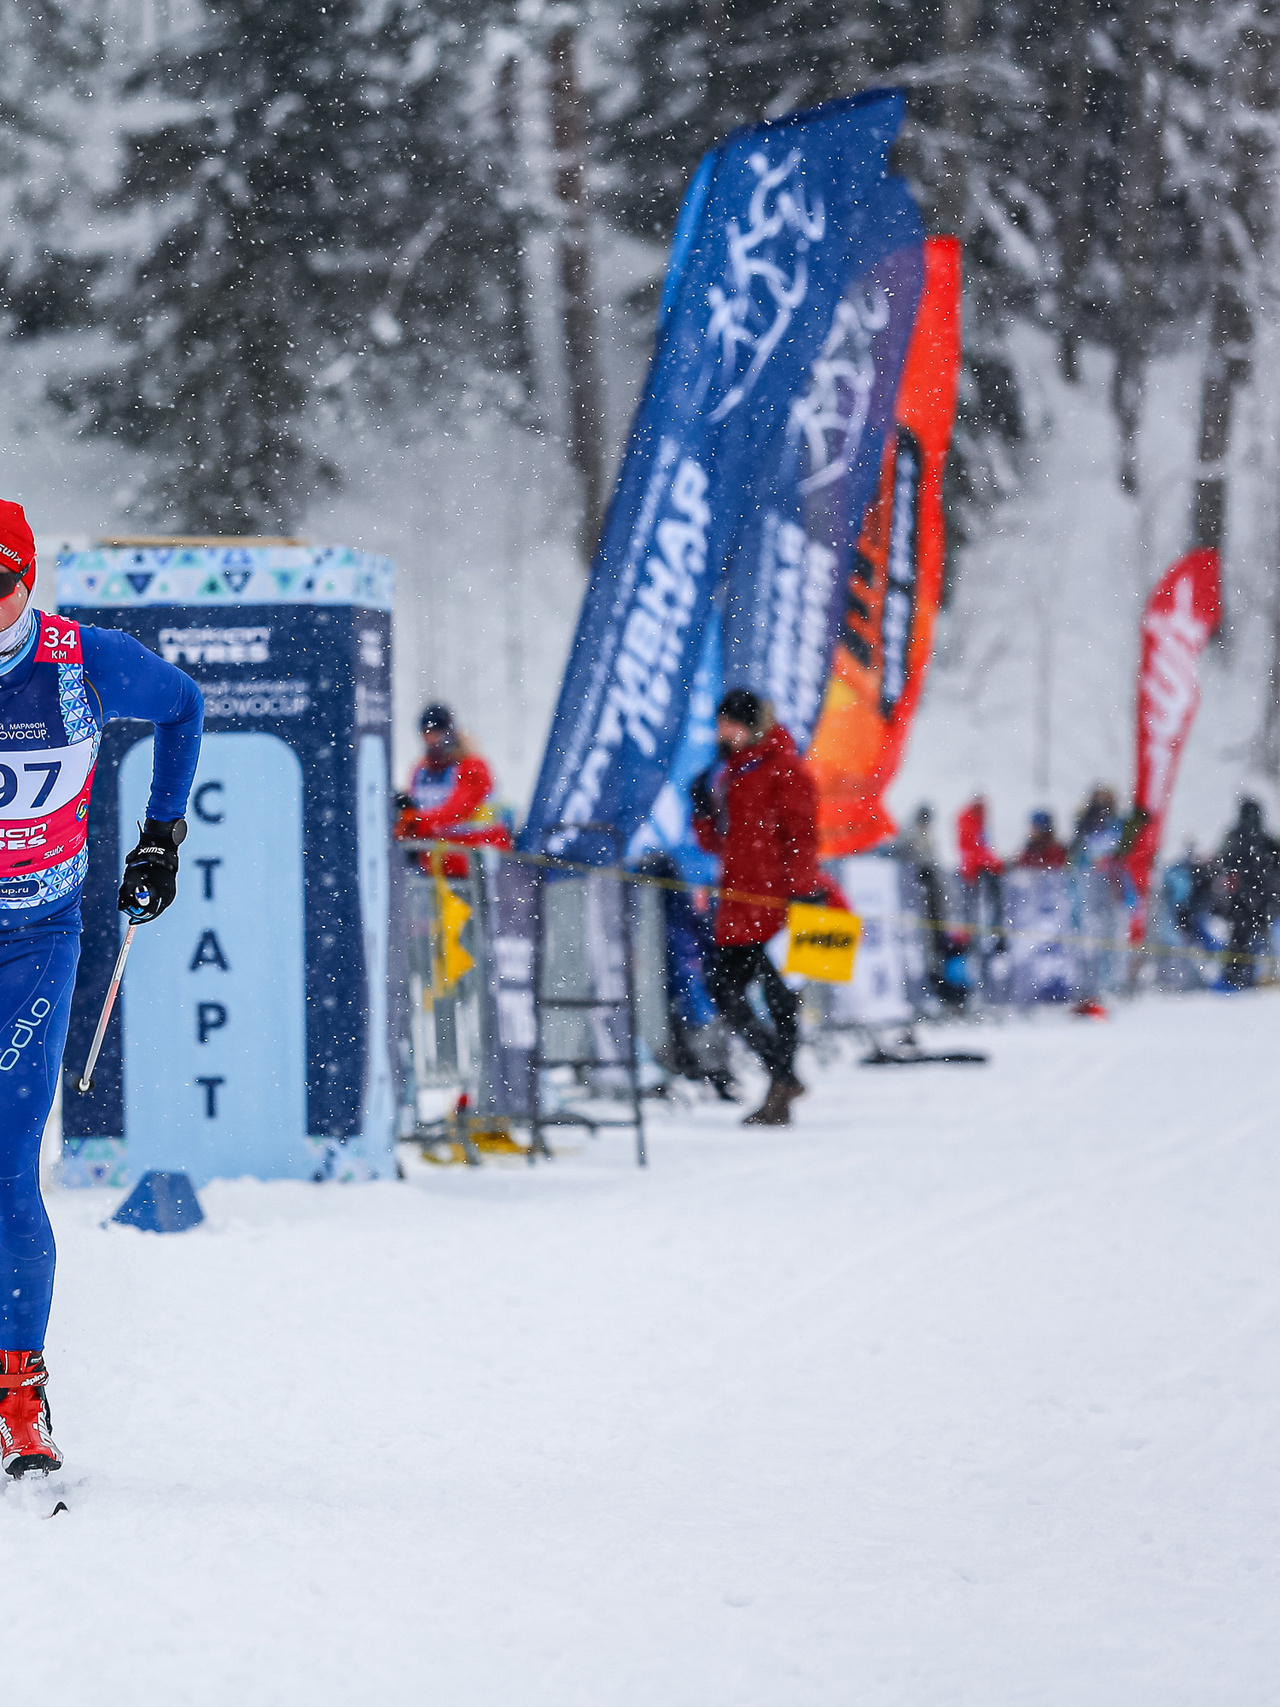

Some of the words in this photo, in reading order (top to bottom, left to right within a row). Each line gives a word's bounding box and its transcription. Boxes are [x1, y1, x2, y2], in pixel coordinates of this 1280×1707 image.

[43, 626, 78, 649] 34
[9, 721, 46, 730] МАРАФОН
[188, 781, 231, 1119] СТАРТ
[21, 1372, 47, 1387] alpina
